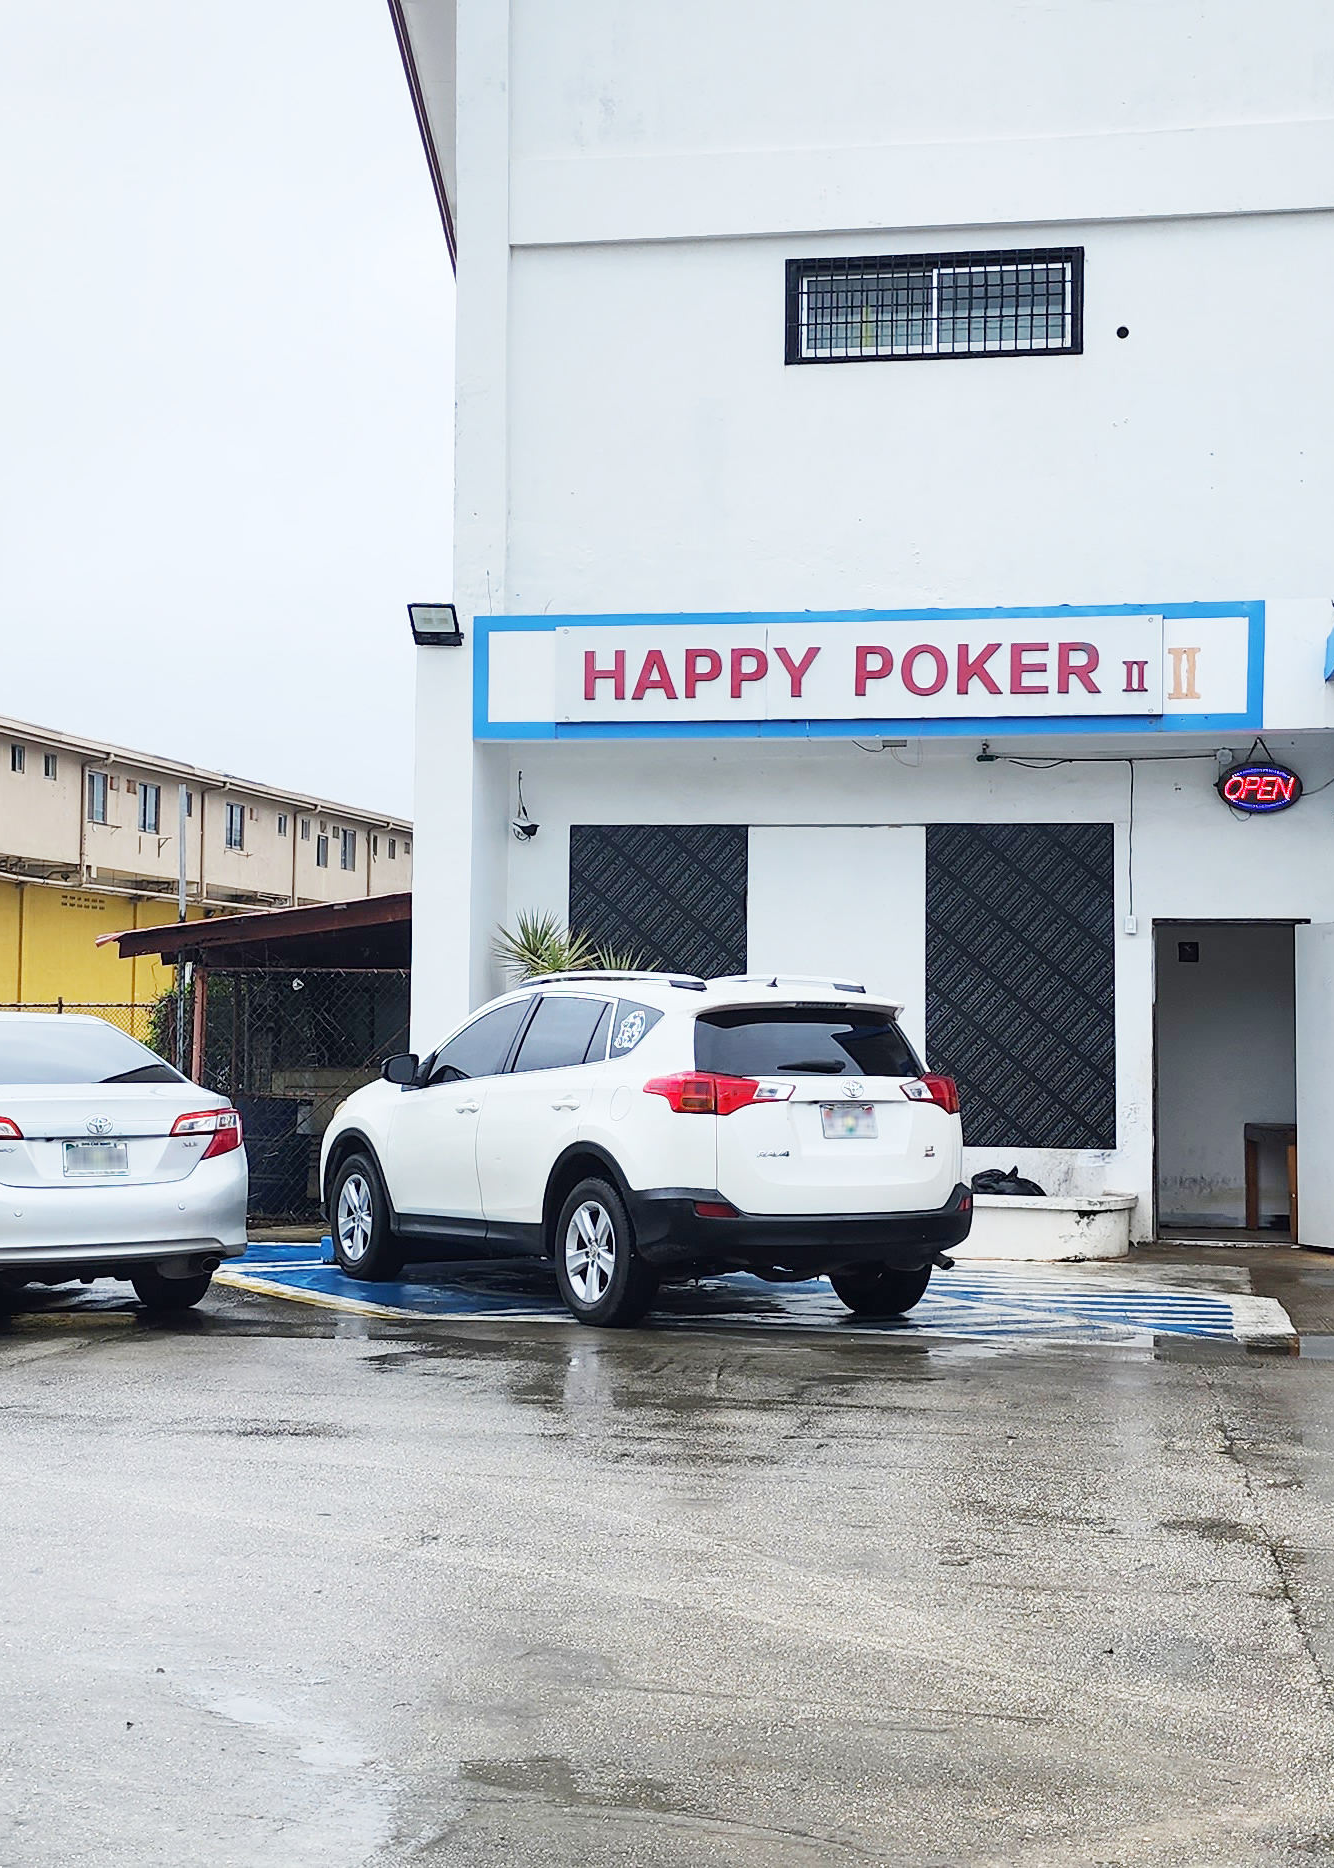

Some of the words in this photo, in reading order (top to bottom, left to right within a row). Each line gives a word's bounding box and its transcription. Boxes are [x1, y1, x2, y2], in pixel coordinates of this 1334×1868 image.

[584, 646, 822, 700] HAPPY
[855, 642, 1102, 696] POKER
[1122, 660, 1149, 692] II
[1224, 776, 1295, 801] OPEN
